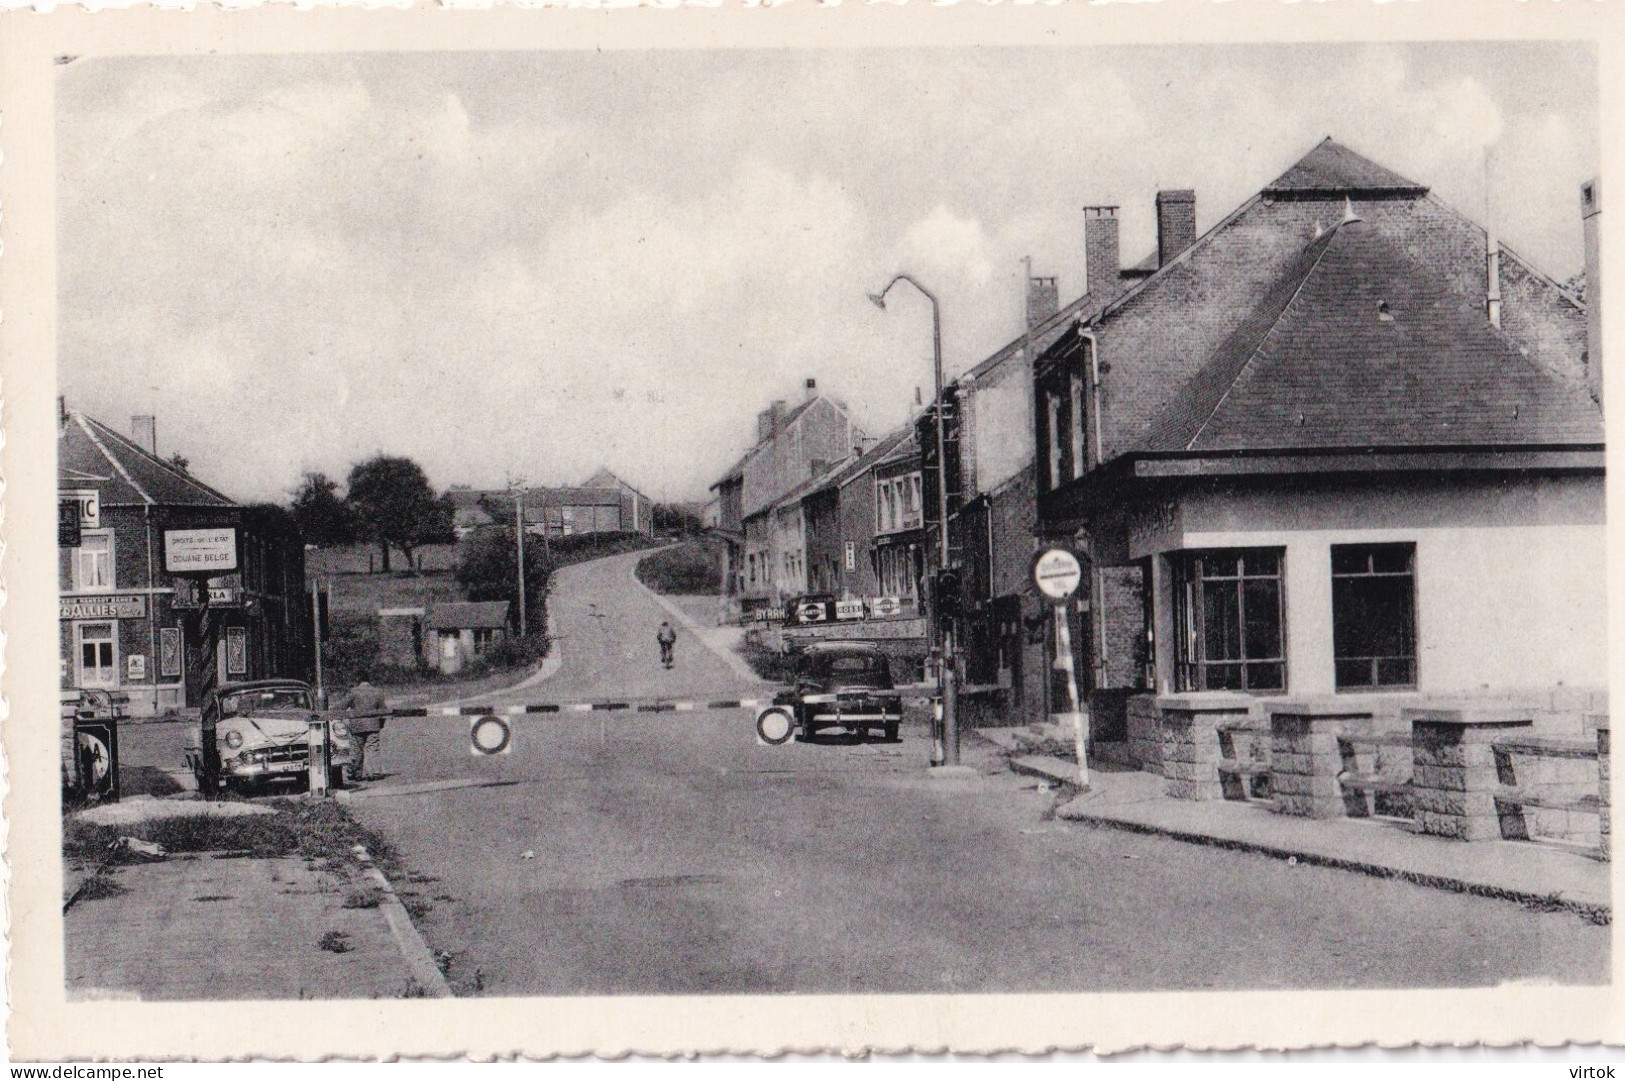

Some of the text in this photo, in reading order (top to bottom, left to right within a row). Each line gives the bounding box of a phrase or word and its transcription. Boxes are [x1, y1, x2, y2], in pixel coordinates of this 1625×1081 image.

[80, 500, 95, 518] IC
[173, 553, 230, 563] DOUANE BELGE
